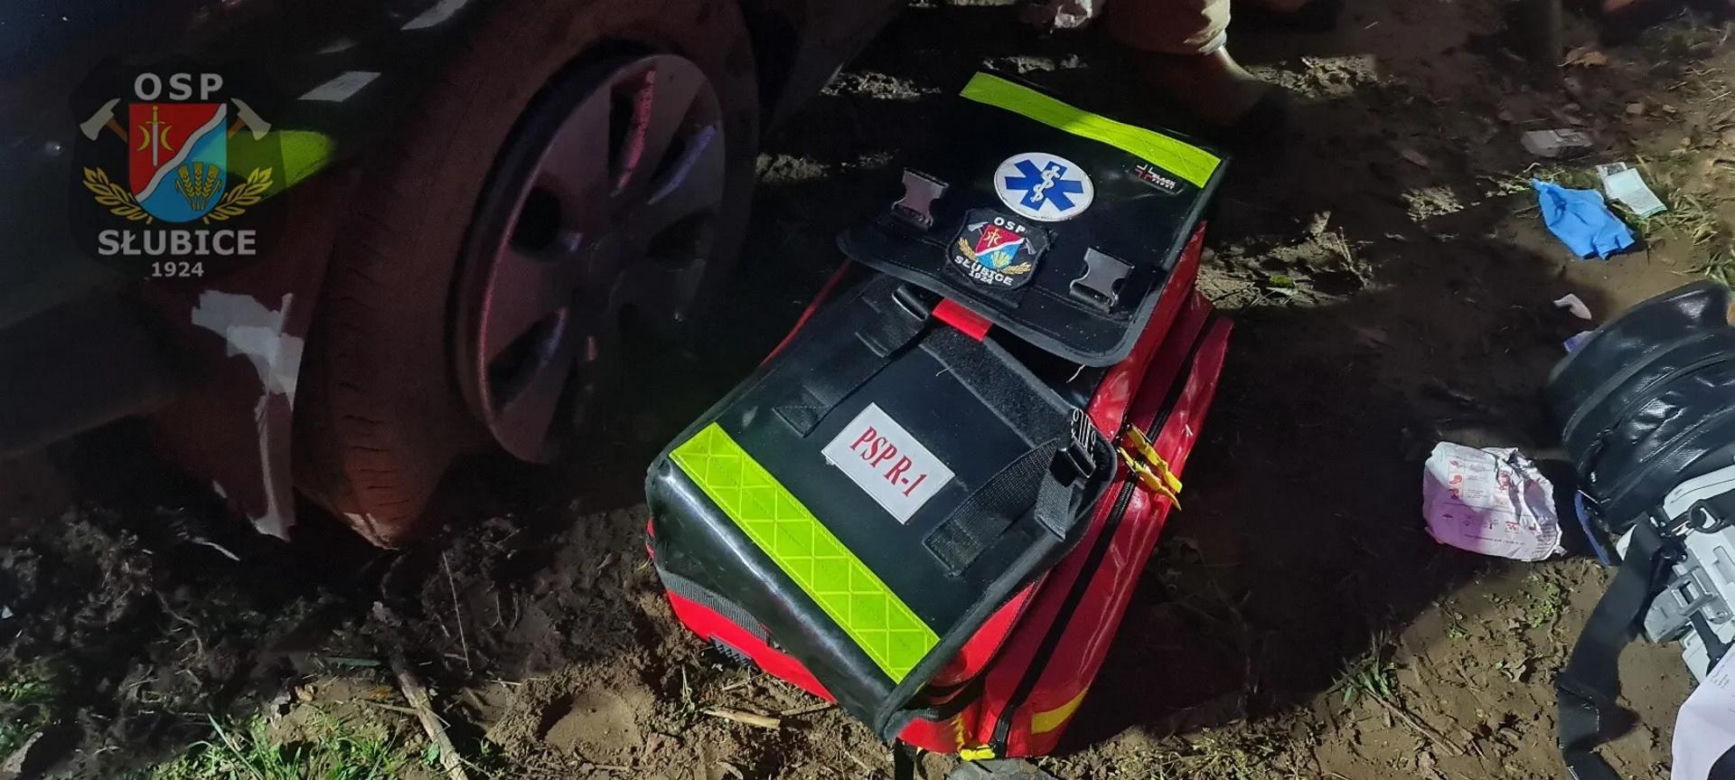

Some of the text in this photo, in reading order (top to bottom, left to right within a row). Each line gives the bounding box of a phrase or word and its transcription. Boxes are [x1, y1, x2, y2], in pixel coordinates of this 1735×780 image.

[993, 216, 1026, 233] OSP
[954, 255, 1014, 286] SŁUBICE
[850, 426, 927, 497] PSP R-1
